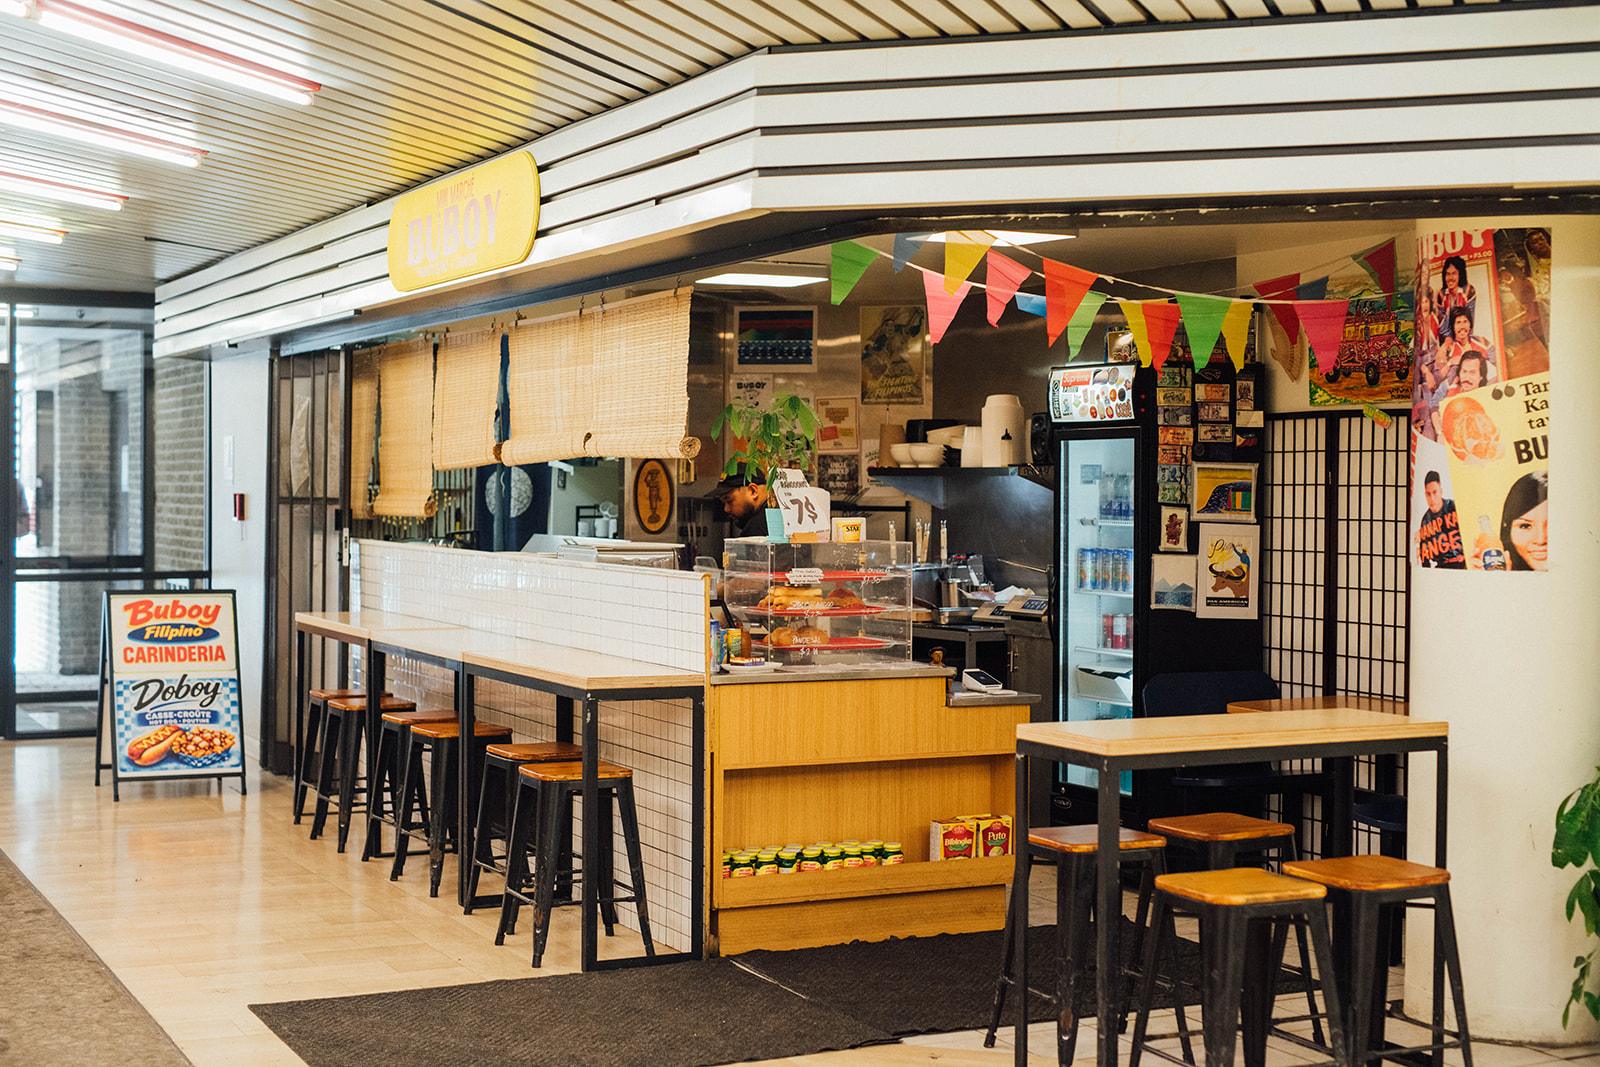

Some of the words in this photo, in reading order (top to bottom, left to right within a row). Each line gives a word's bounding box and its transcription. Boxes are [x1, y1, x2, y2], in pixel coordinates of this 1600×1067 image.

[408, 190, 501, 267] BUBOY
[736, 381, 767, 390] BUBOY
[874, 384, 912, 399] FILIPINOS
[1523, 398, 1549, 414] Ka
[1513, 435, 1549, 465] BU
[790, 496, 818, 525] 7$
[123, 600, 221, 627] Buboy
[144, 625, 203, 640] Filipino
[123, 645, 226, 664] CARINDERIA
[132, 674, 223, 711] Doboy
[988, 831, 1006, 841] Puto
